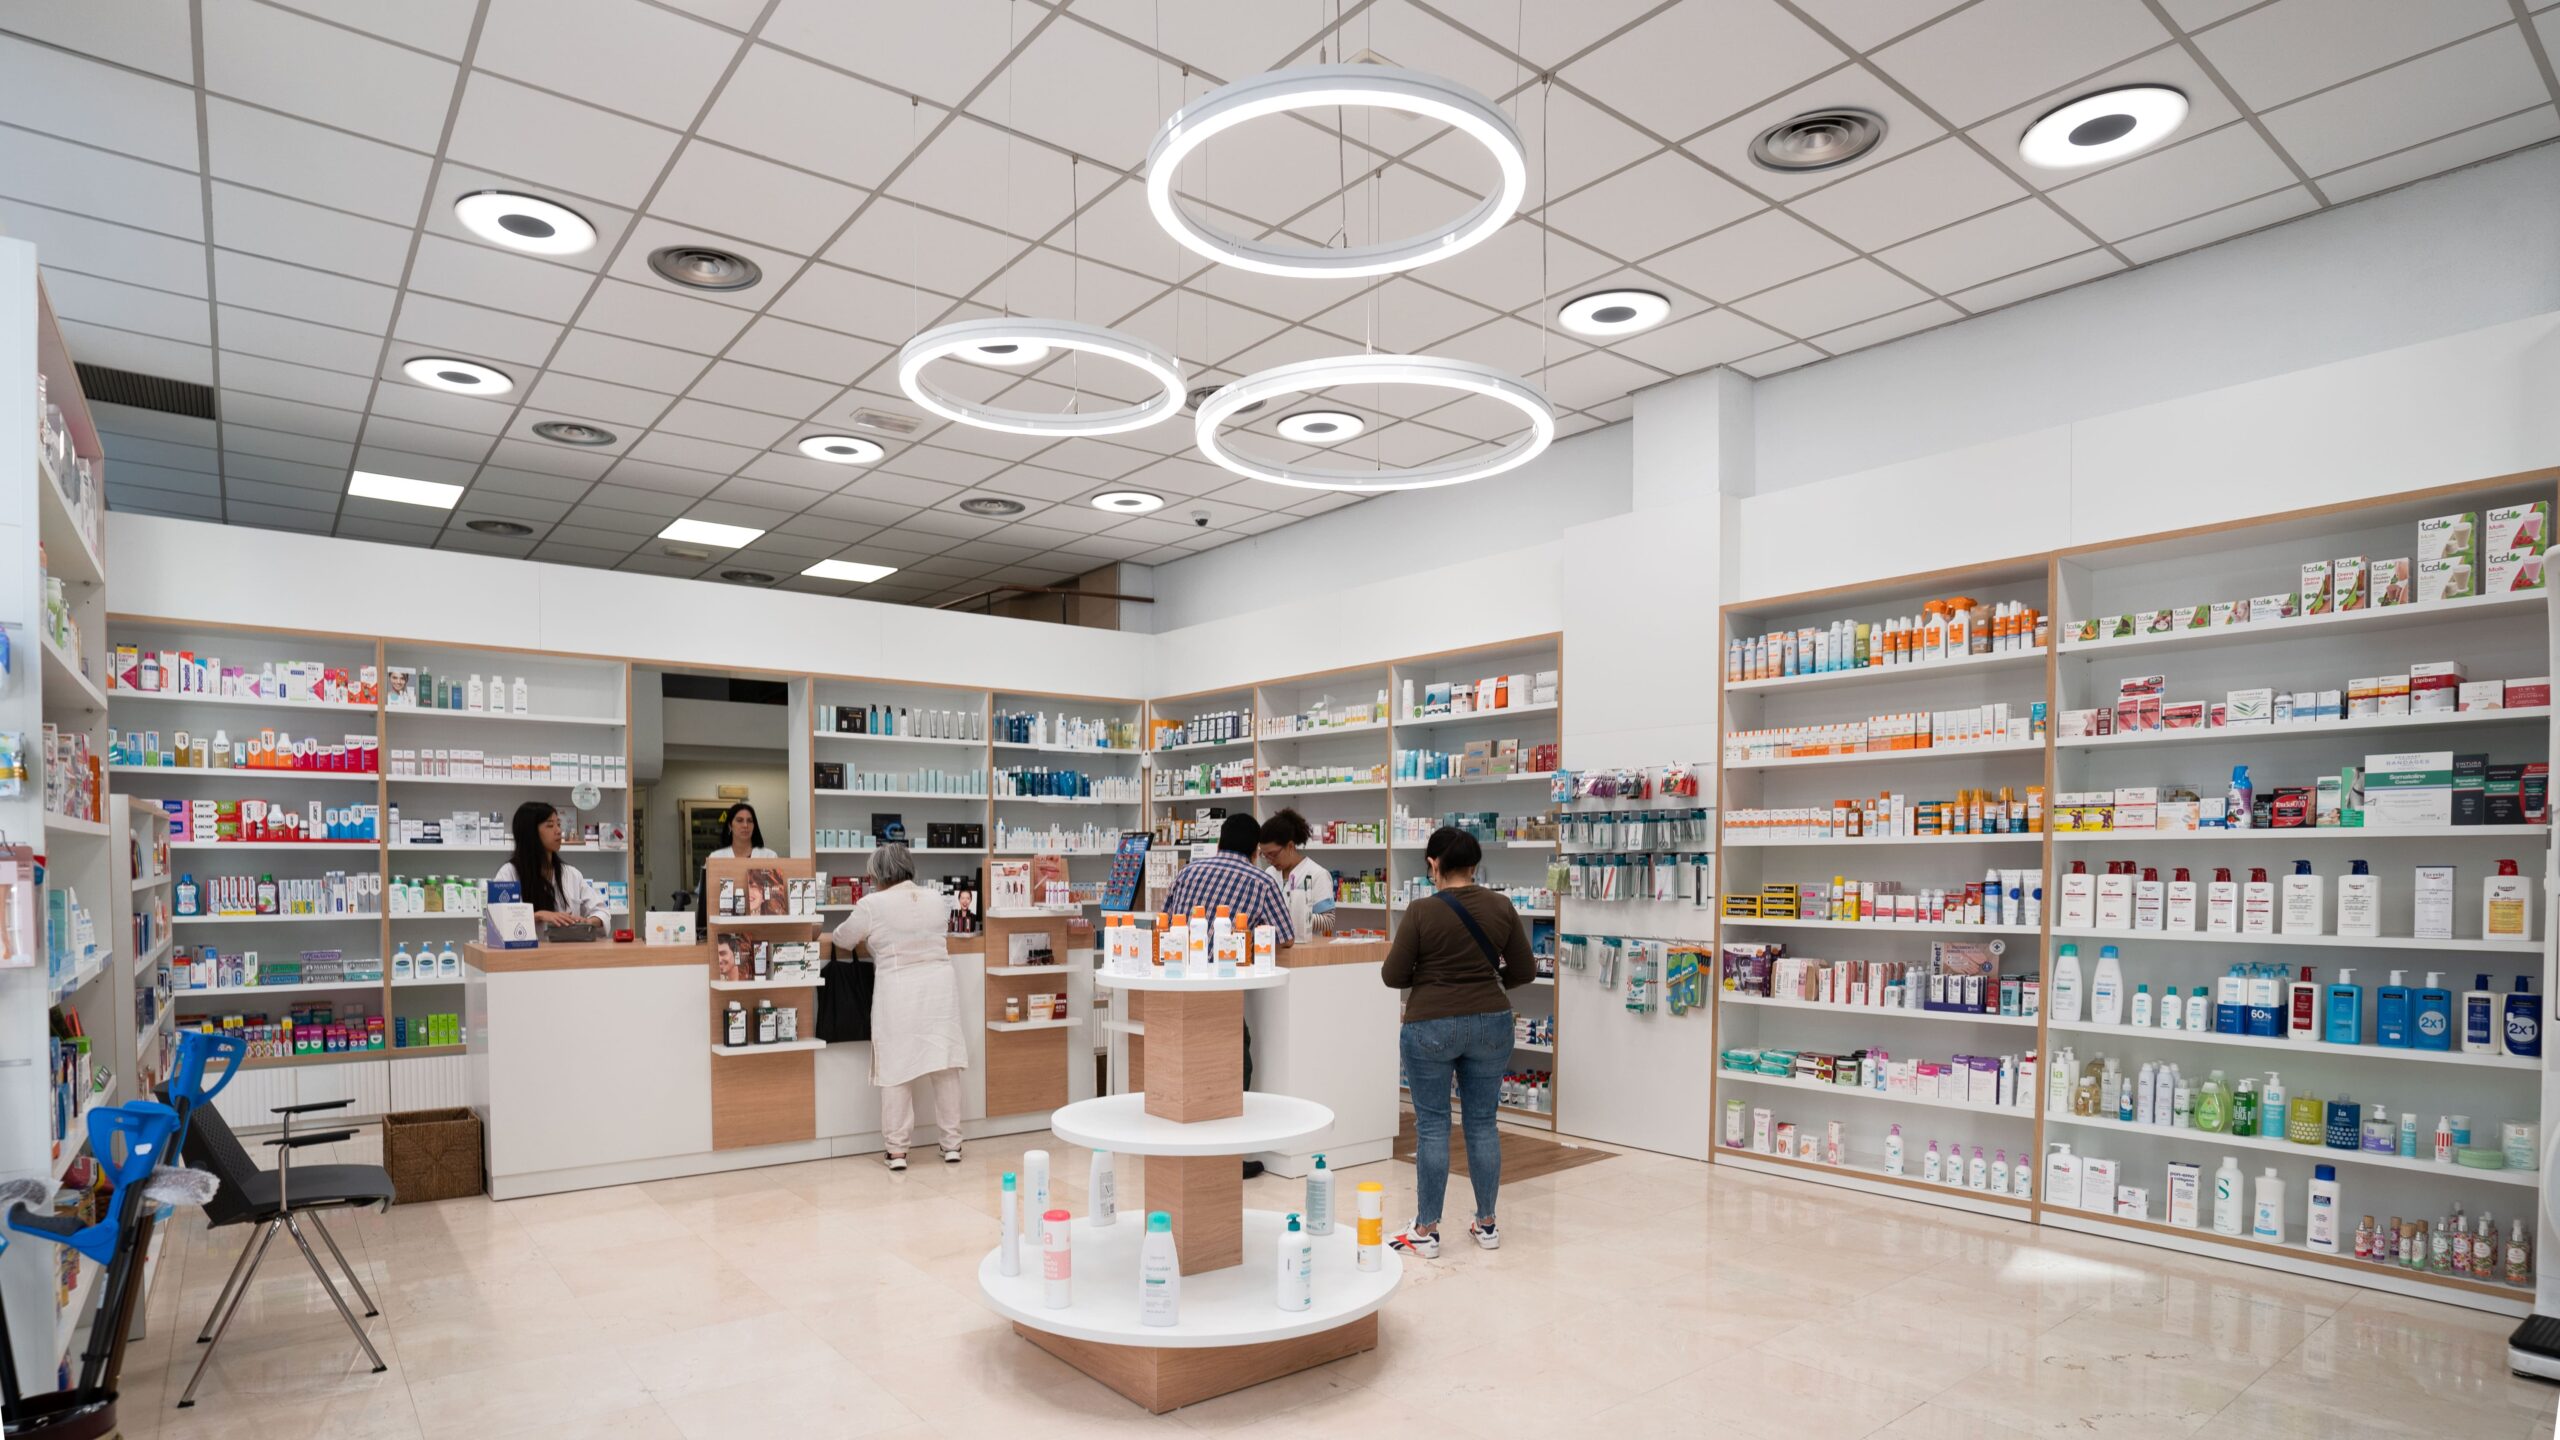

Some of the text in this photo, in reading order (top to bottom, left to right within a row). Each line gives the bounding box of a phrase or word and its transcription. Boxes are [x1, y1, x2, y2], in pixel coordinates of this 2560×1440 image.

[2489, 510, 2511, 522] tcd
[2421, 520, 2441, 532] tcd
[2488, 552, 2510, 564] tcd
[2304, 564, 2319, 573] tcd
[2336, 560, 2352, 568] tcd
[2421, 562, 2440, 572] tcd
[2250, 1009, 2272, 1020] 60%
[2420, 1017, 2444, 1029] 2x1
[2508, 1022, 2537, 1036] 2x1
[2052, 1068, 2064, 1079] ia
[2267, 1090, 2280, 1101] ia
[2404, 1120, 2415, 1130] ia
[2366, 1127, 2375, 1135] ia
[2216, 1177, 2229, 1200] S
